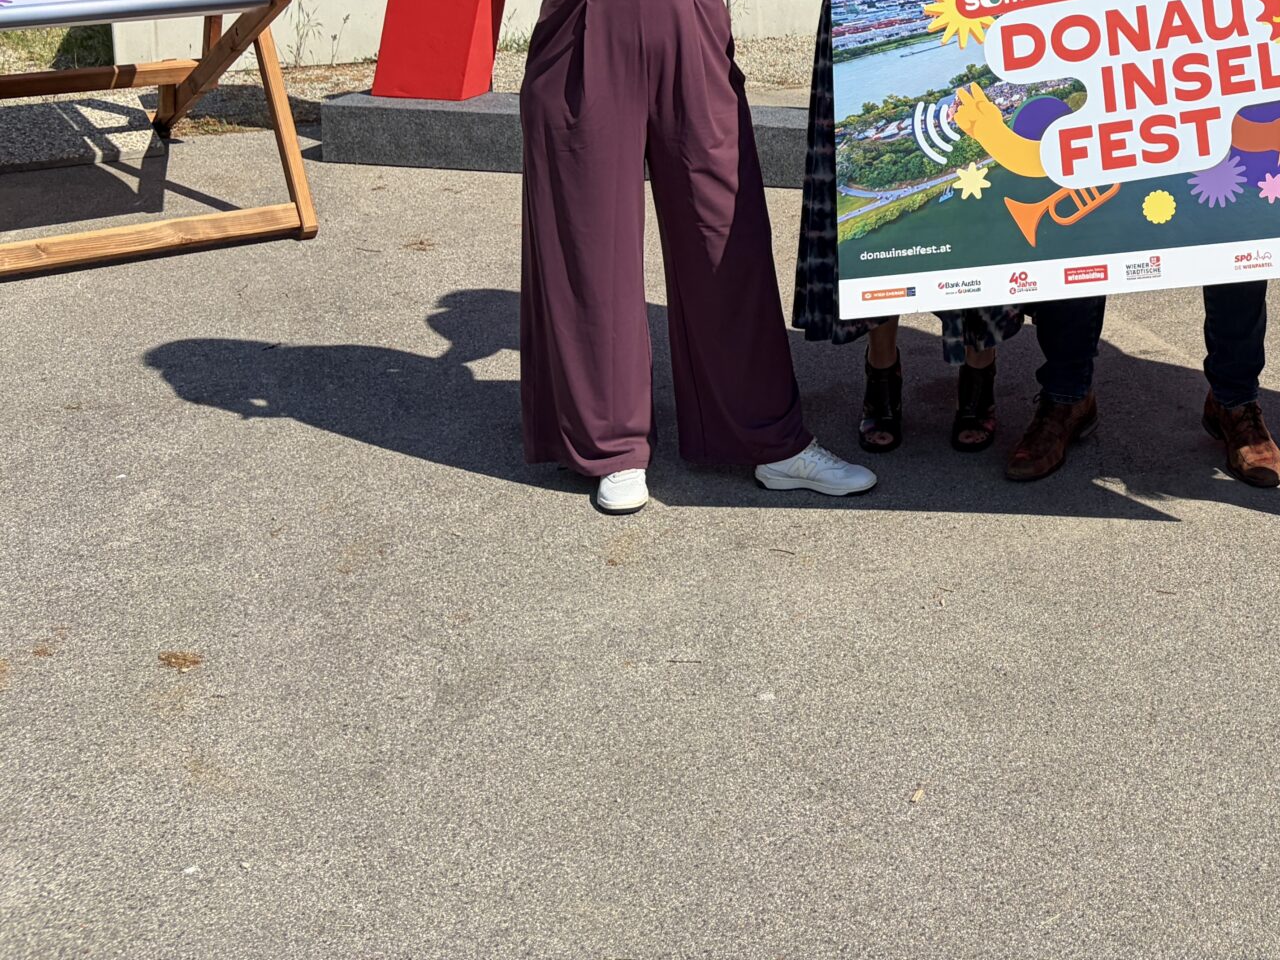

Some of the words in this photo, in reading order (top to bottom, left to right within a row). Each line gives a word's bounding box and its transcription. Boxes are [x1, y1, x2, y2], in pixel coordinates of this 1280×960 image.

[1058, 106, 1223, 177] FEST
[860, 243, 952, 261] donauinselfest.at
[1234, 252, 1252, 263] SPÖ
[1125, 262, 1150, 271] WIENER
[1009, 271, 1028, 285] 40
[944, 281, 961, 289] Bank
[961, 279, 982, 287] Austria
[1017, 280, 1037, 288] Jahre
